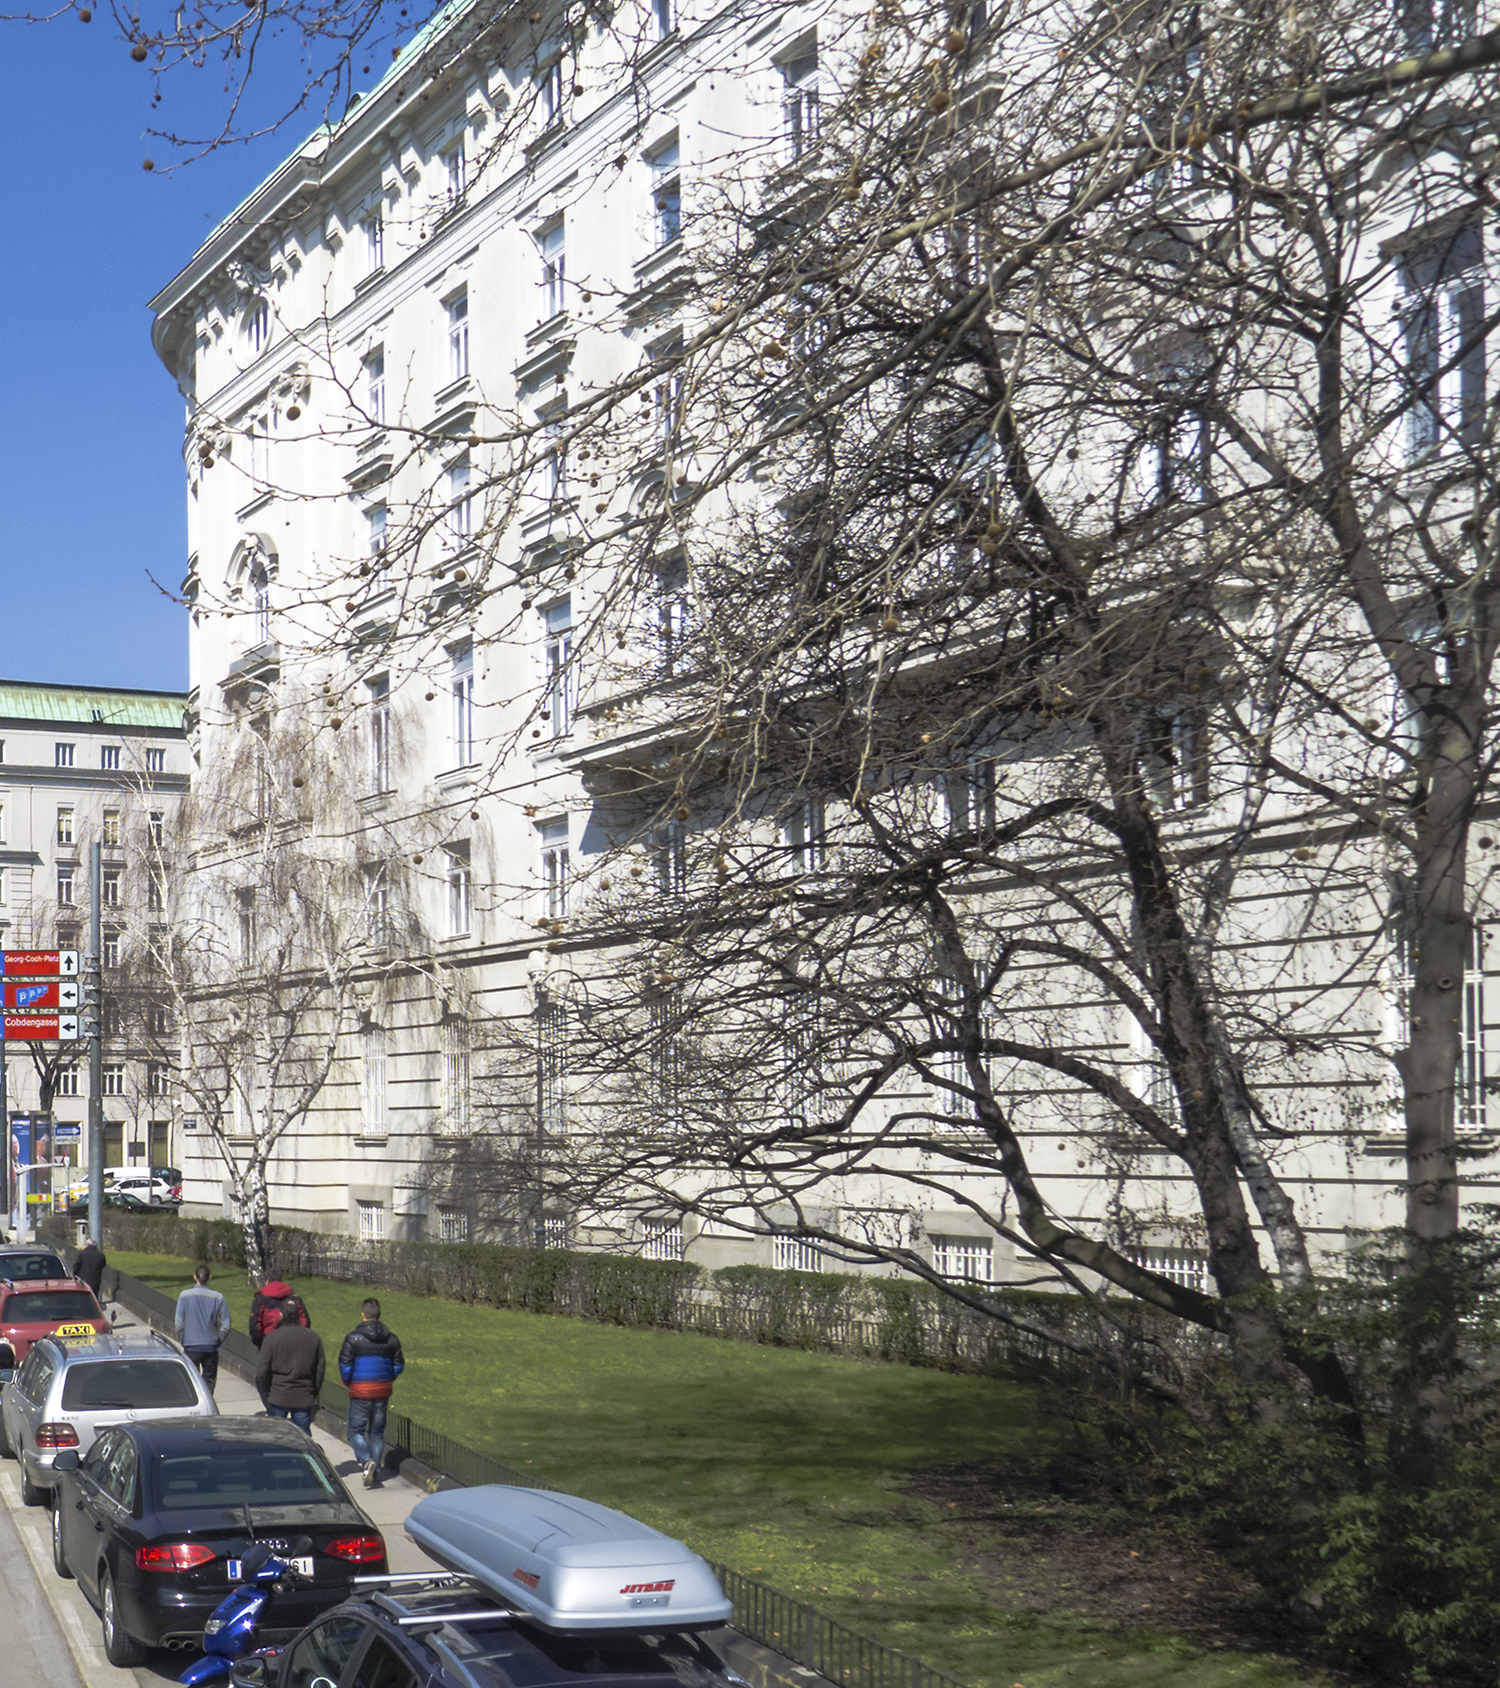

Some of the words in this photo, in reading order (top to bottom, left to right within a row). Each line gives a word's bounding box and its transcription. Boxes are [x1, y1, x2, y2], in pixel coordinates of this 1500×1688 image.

[4, 955, 59, 963] Georg-Coch-Platz
[4, 1017, 58, 1028] Cobdengasse
[64, 1326, 89, 1335] TAXI
